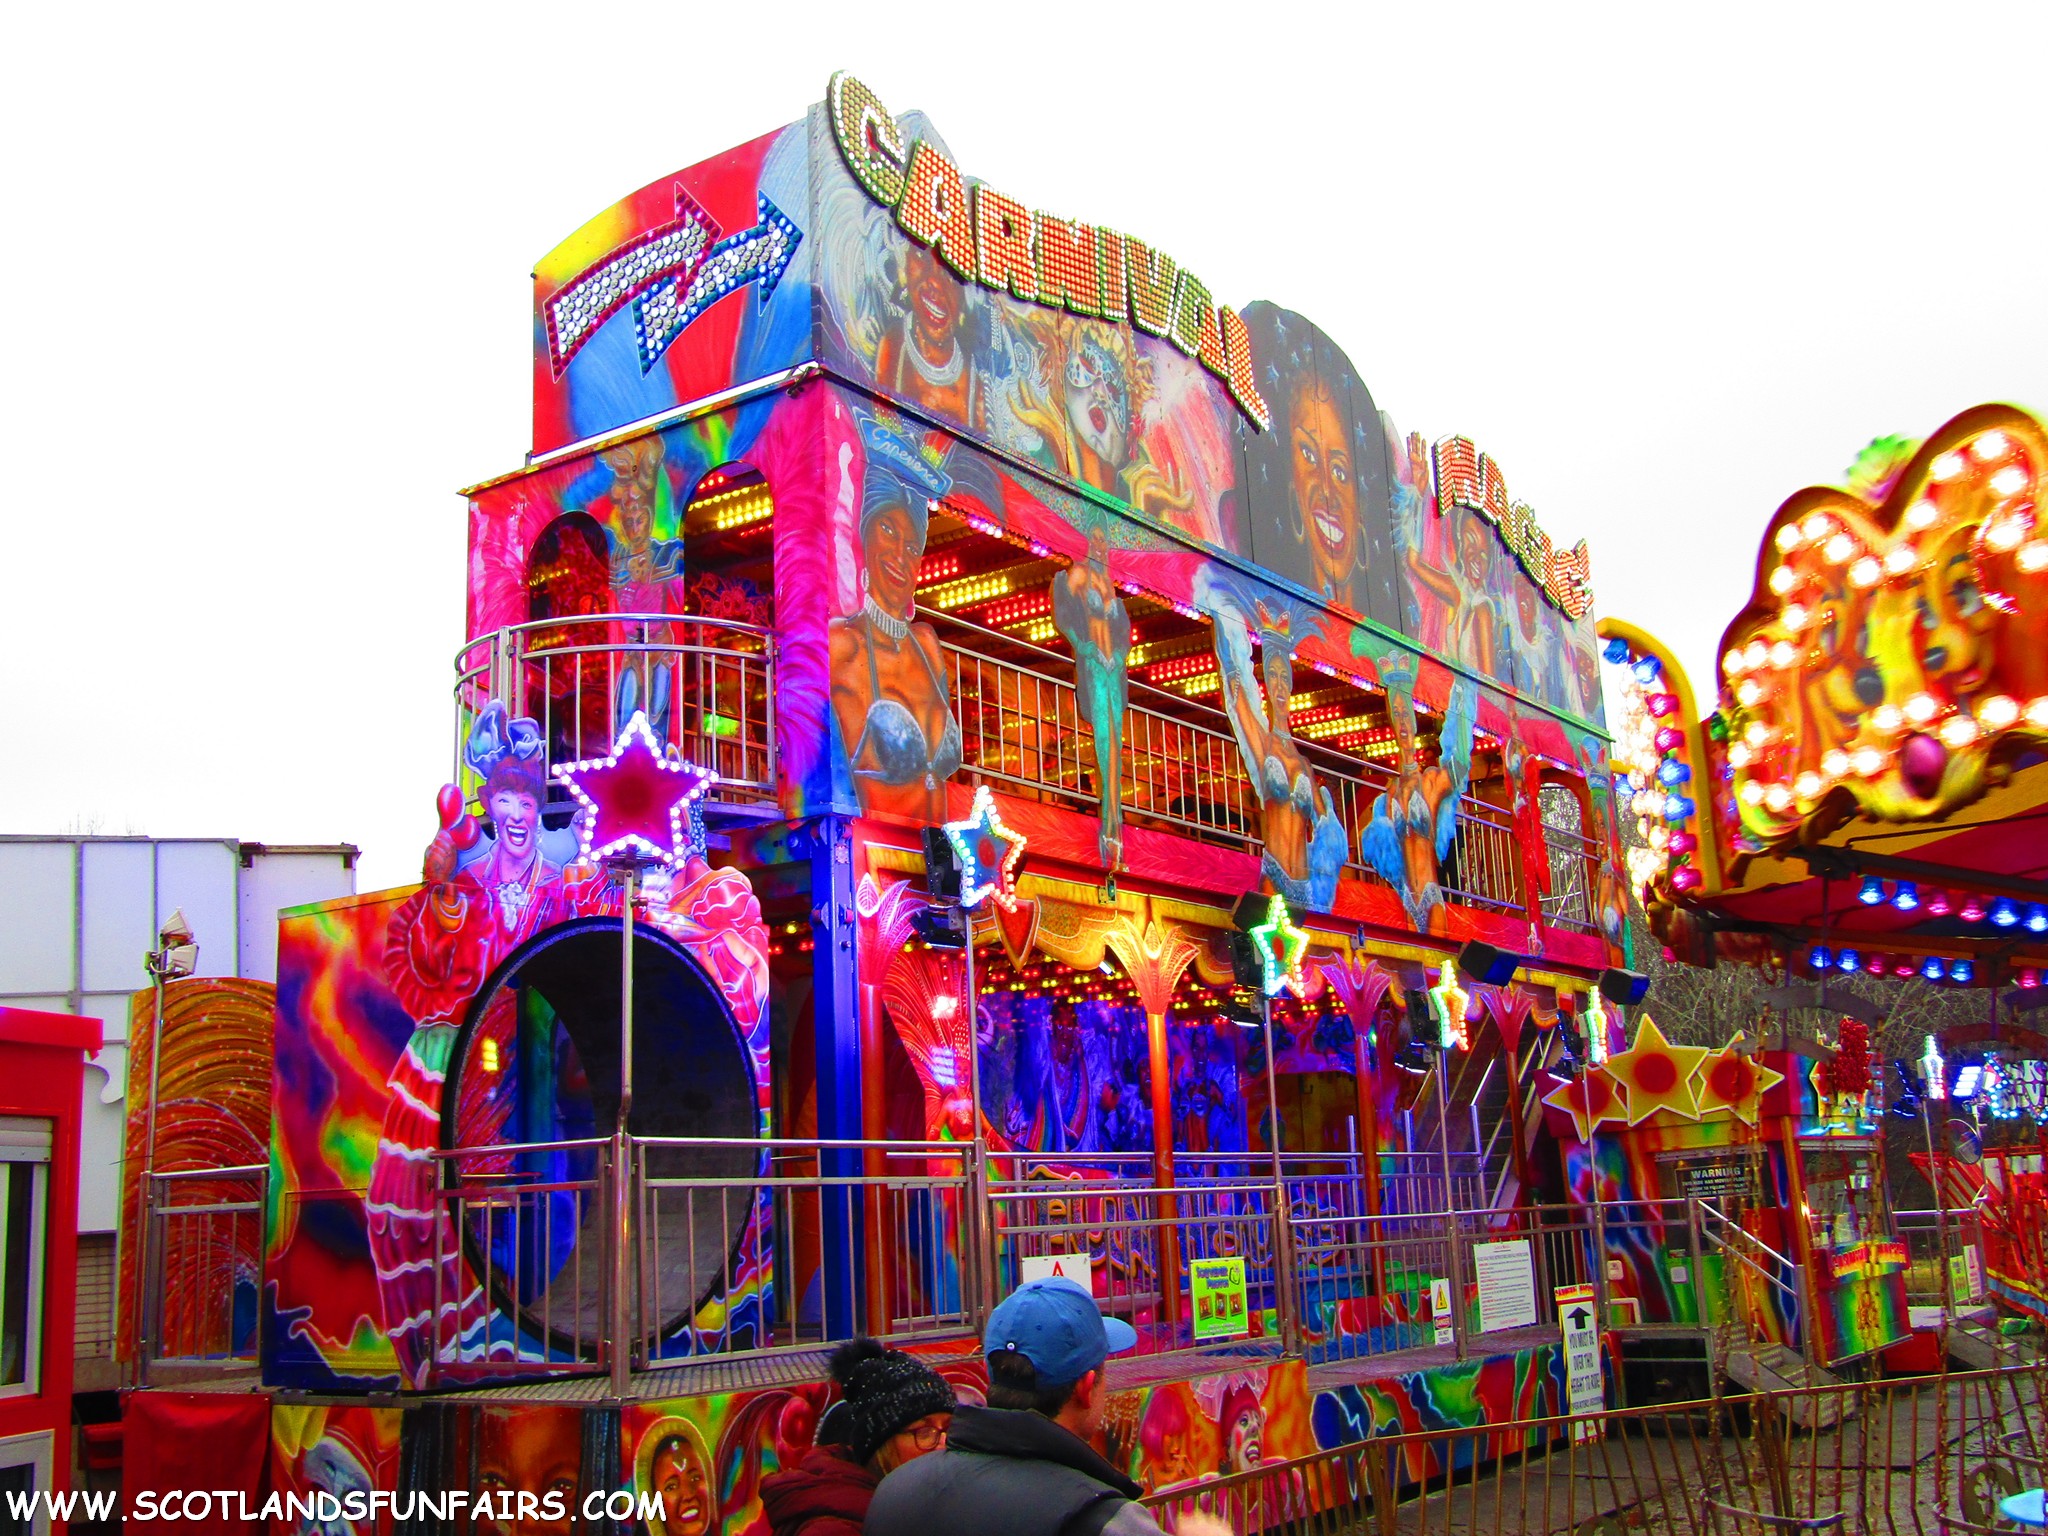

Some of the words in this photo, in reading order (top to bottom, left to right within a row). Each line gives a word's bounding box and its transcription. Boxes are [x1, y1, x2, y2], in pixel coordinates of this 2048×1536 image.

[826, 69, 1270, 434] CARNIVAL
[1433, 434, 1595, 621] MAGIC
[2004, 1060, 2048, 1083] SK
[1691, 1167, 1741, 1179] WARNING
